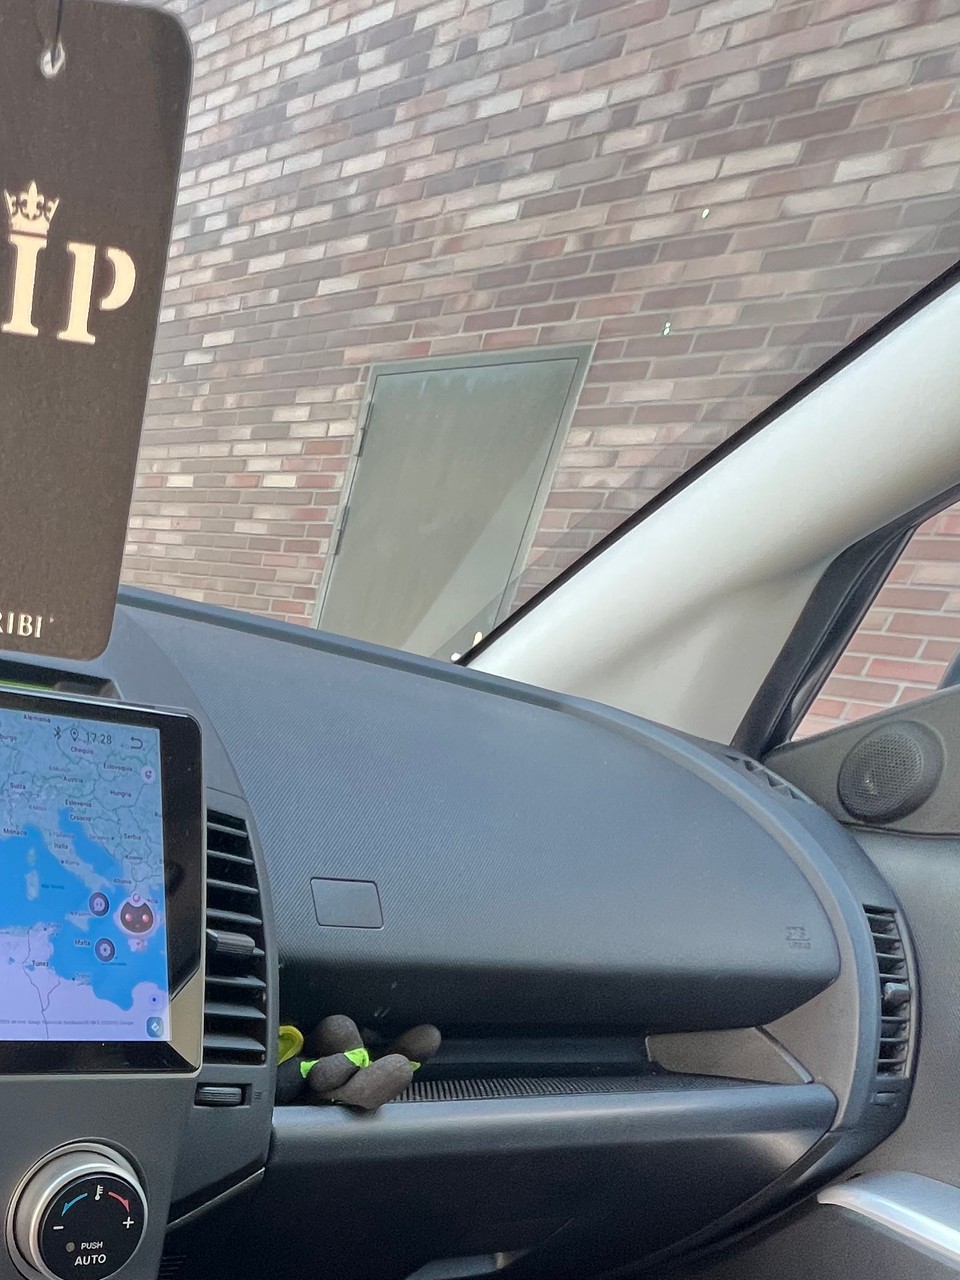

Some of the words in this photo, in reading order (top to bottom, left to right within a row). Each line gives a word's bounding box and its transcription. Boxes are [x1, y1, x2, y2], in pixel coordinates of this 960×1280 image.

[23, 714, 51, 723] Alemania
[86, 732, 112, 745] 17:28
[63, 776, 84, 784] Austria
[9, 782, 27, 790] Suiza
[123, 833, 142, 841] Serbia
[53, 842, 69, 850] Italia
[81, 1241, 103, 1250] PUSH
[74, 1254, 107, 1266] AUTO
